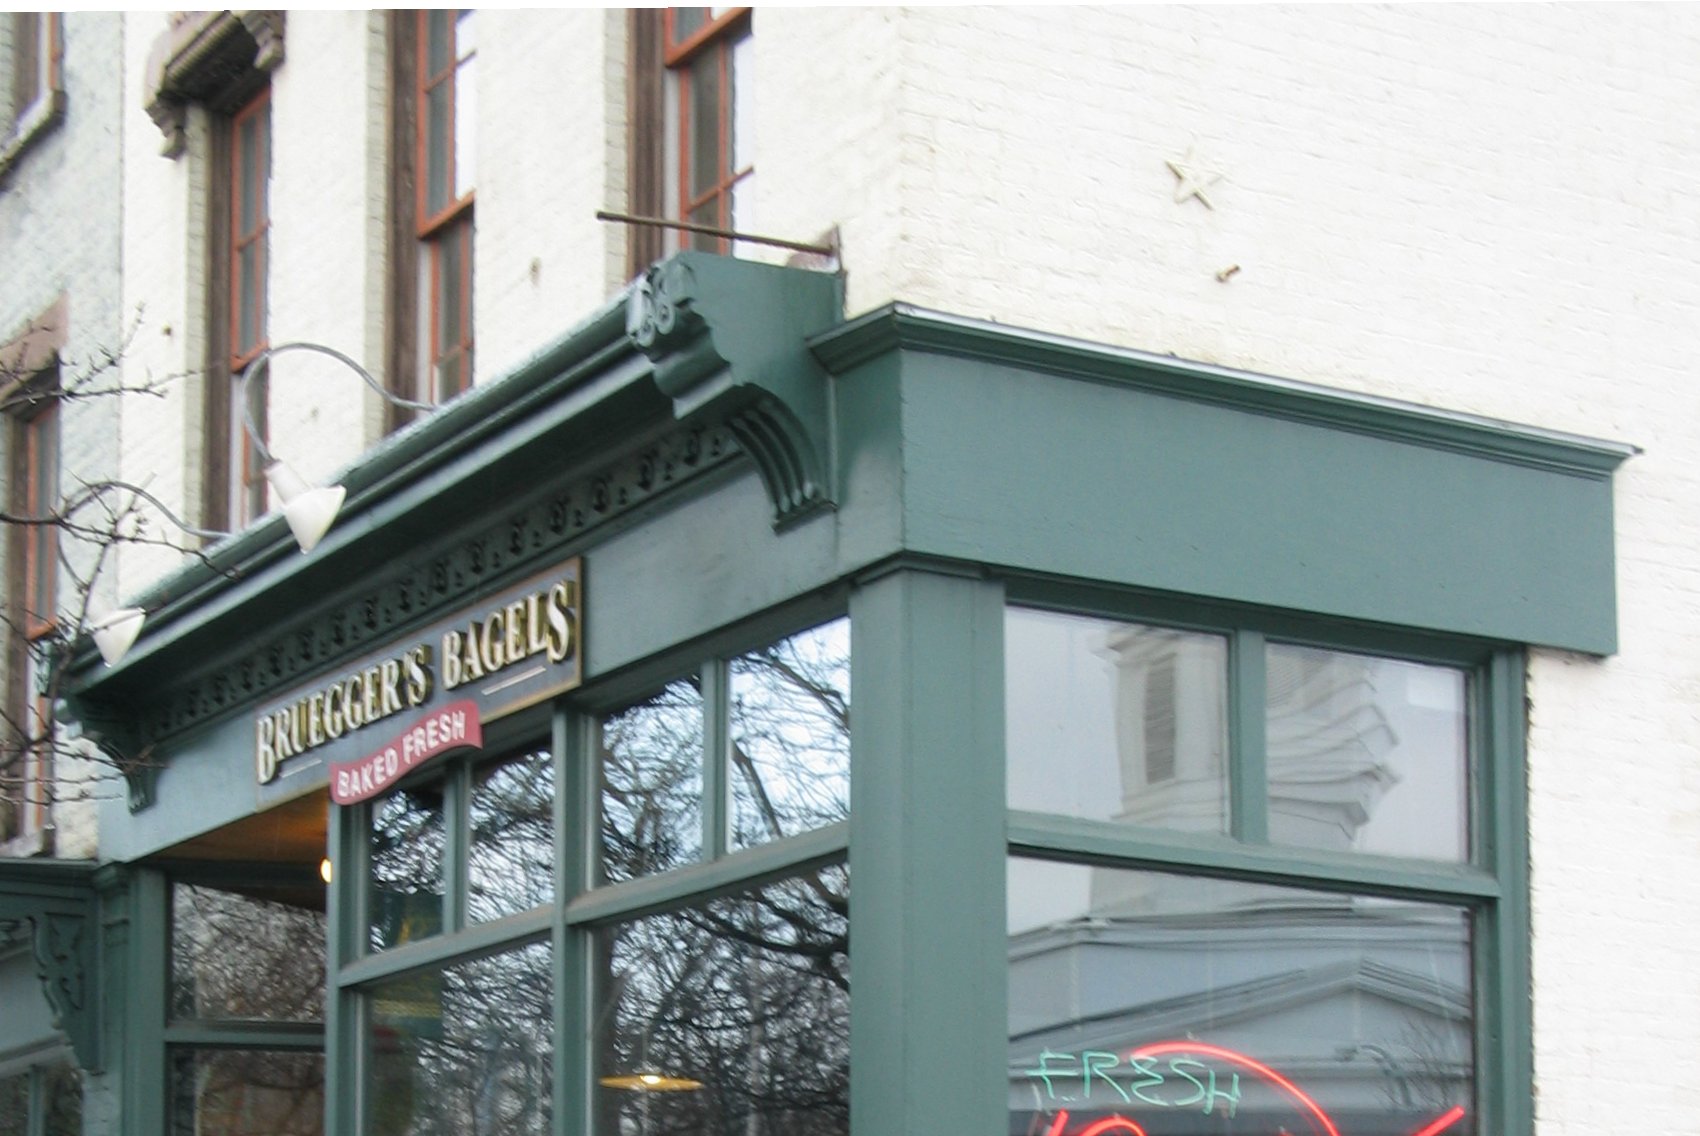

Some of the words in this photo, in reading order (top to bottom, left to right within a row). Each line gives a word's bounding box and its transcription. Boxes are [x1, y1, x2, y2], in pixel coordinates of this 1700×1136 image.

[255, 643, 432, 785] BRUEGGER'S
[441, 579, 575, 691] BAGELS
[336, 746, 400, 799] BAKED
[402, 710, 467, 766] FRESH
[1024, 1050, 1242, 1117] FRESH
